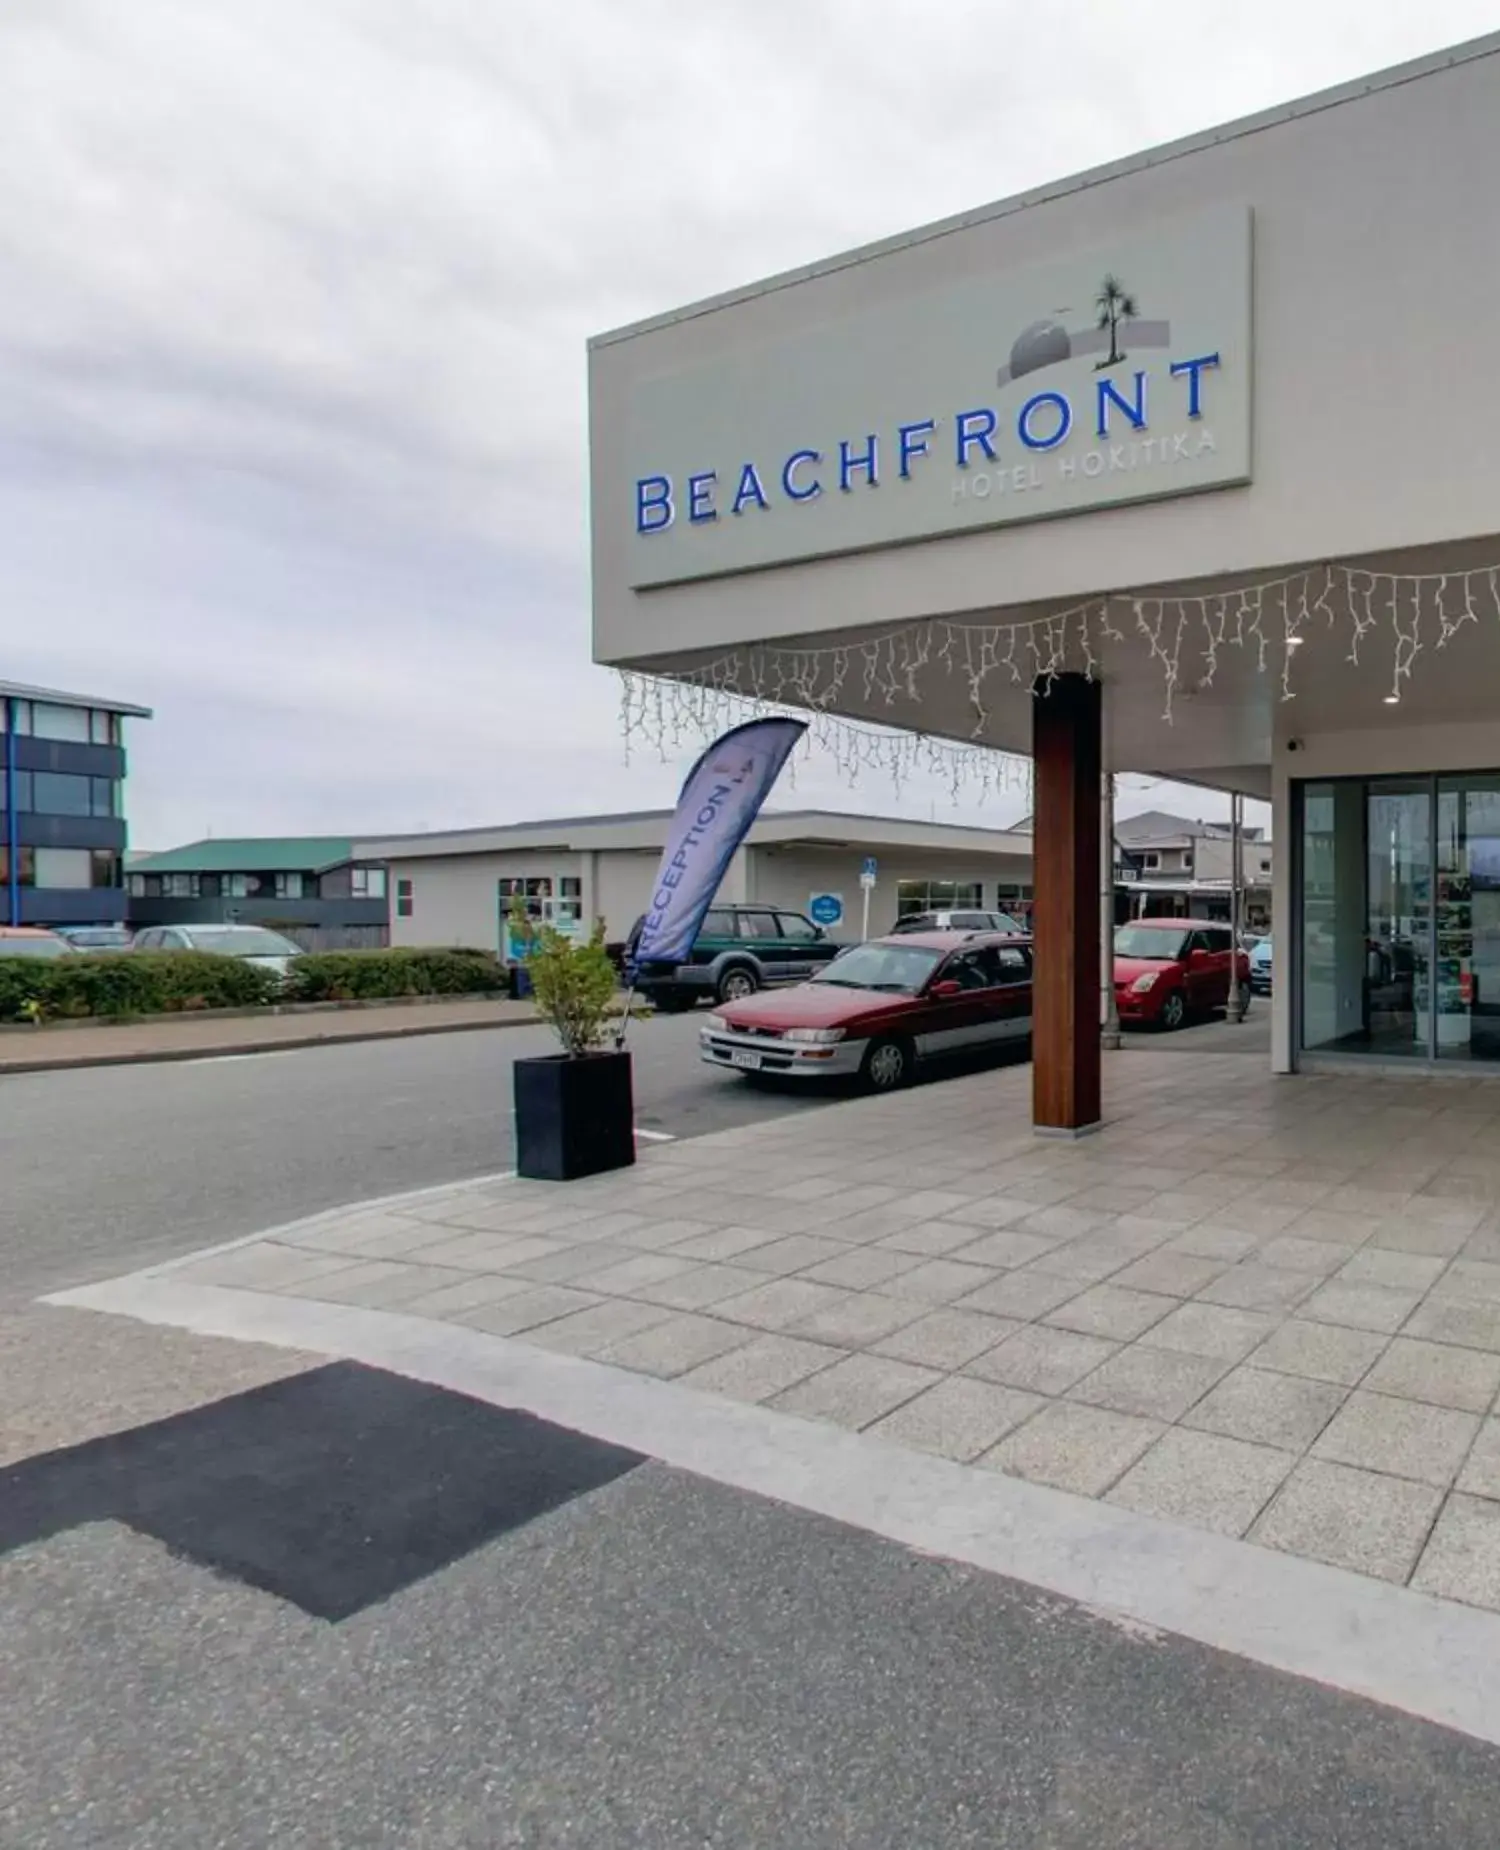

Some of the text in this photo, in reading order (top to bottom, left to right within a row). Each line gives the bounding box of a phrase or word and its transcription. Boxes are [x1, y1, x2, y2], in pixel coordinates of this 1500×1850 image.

[636, 352, 1220, 533] BEACHFRONT
[951, 429, 1216, 504] HOTEL HOKITIKA
